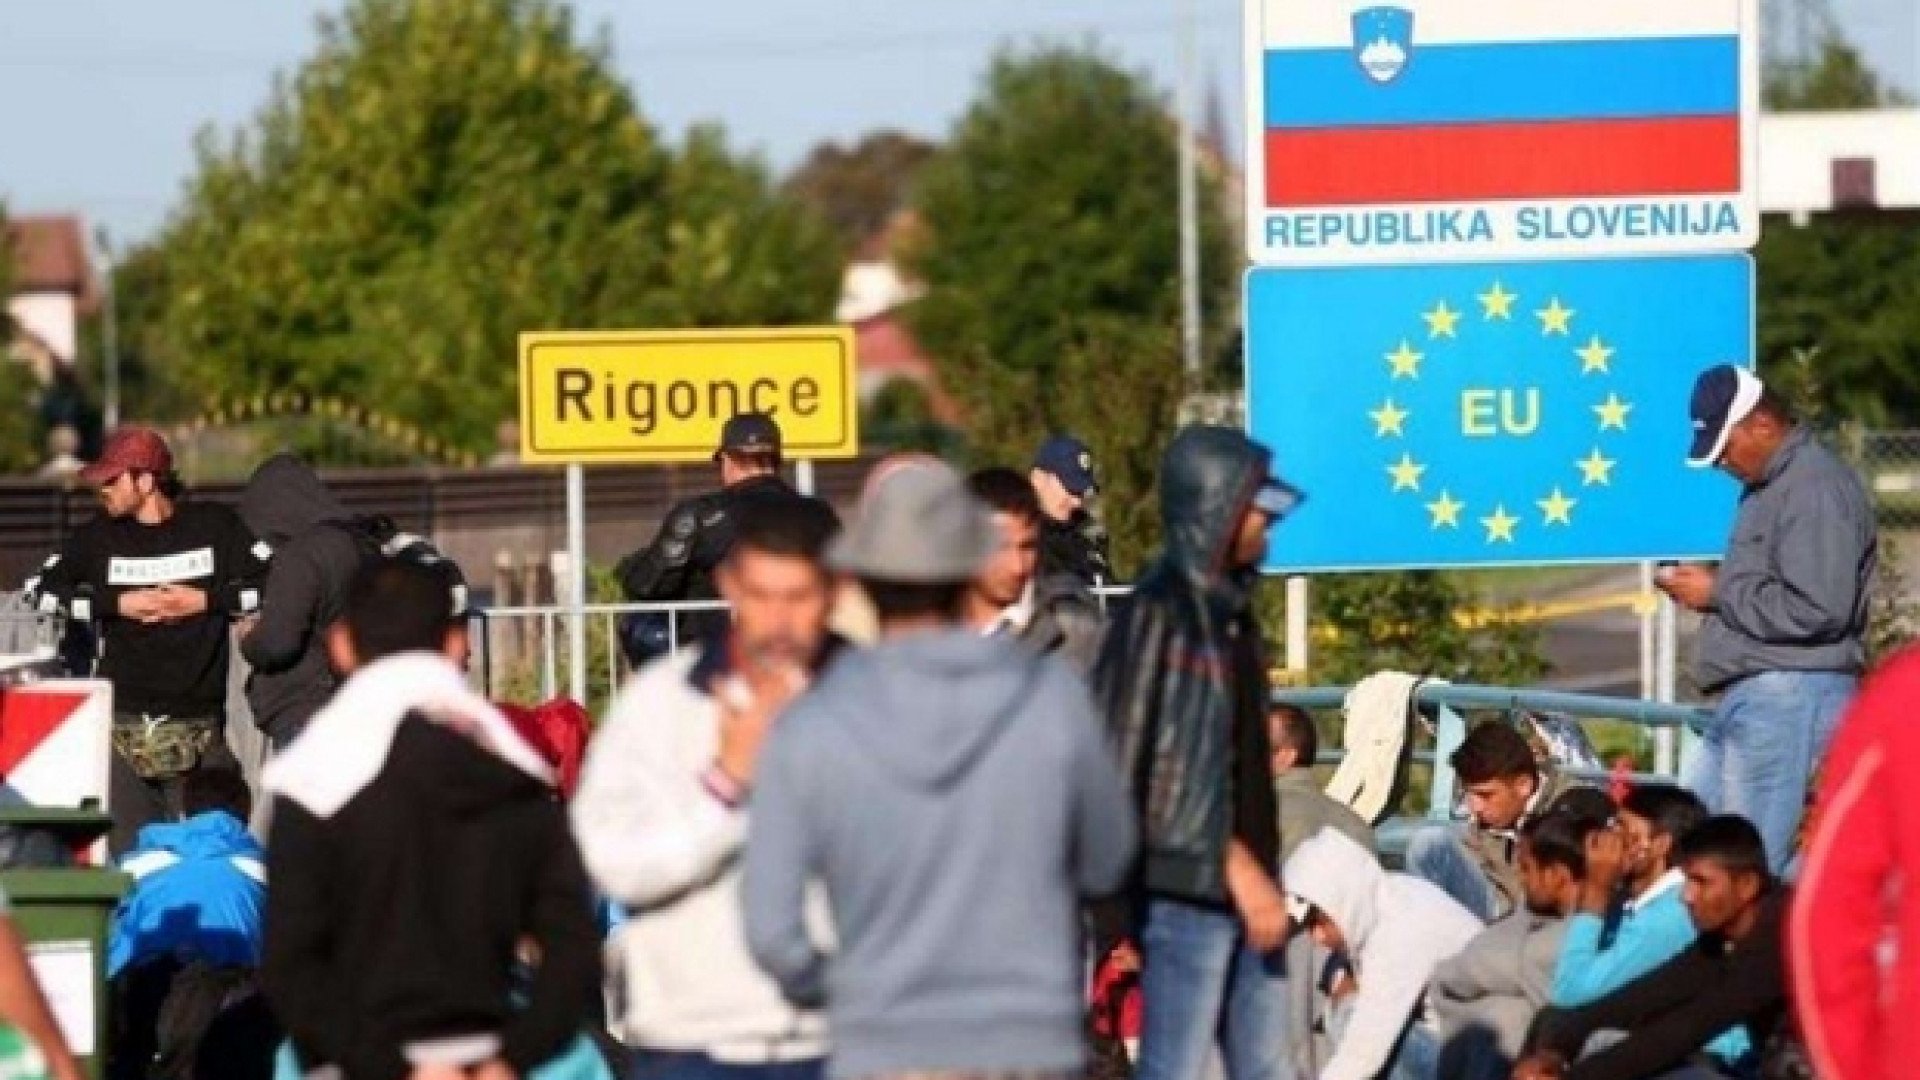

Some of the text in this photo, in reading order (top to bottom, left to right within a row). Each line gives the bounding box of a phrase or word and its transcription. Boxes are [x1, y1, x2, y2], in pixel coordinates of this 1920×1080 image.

[1265, 202, 1741, 248] REPUBLIKA SLOVENIJA
[555, 367, 820, 436] Rigonce
[1460, 387, 1541, 437] EU
